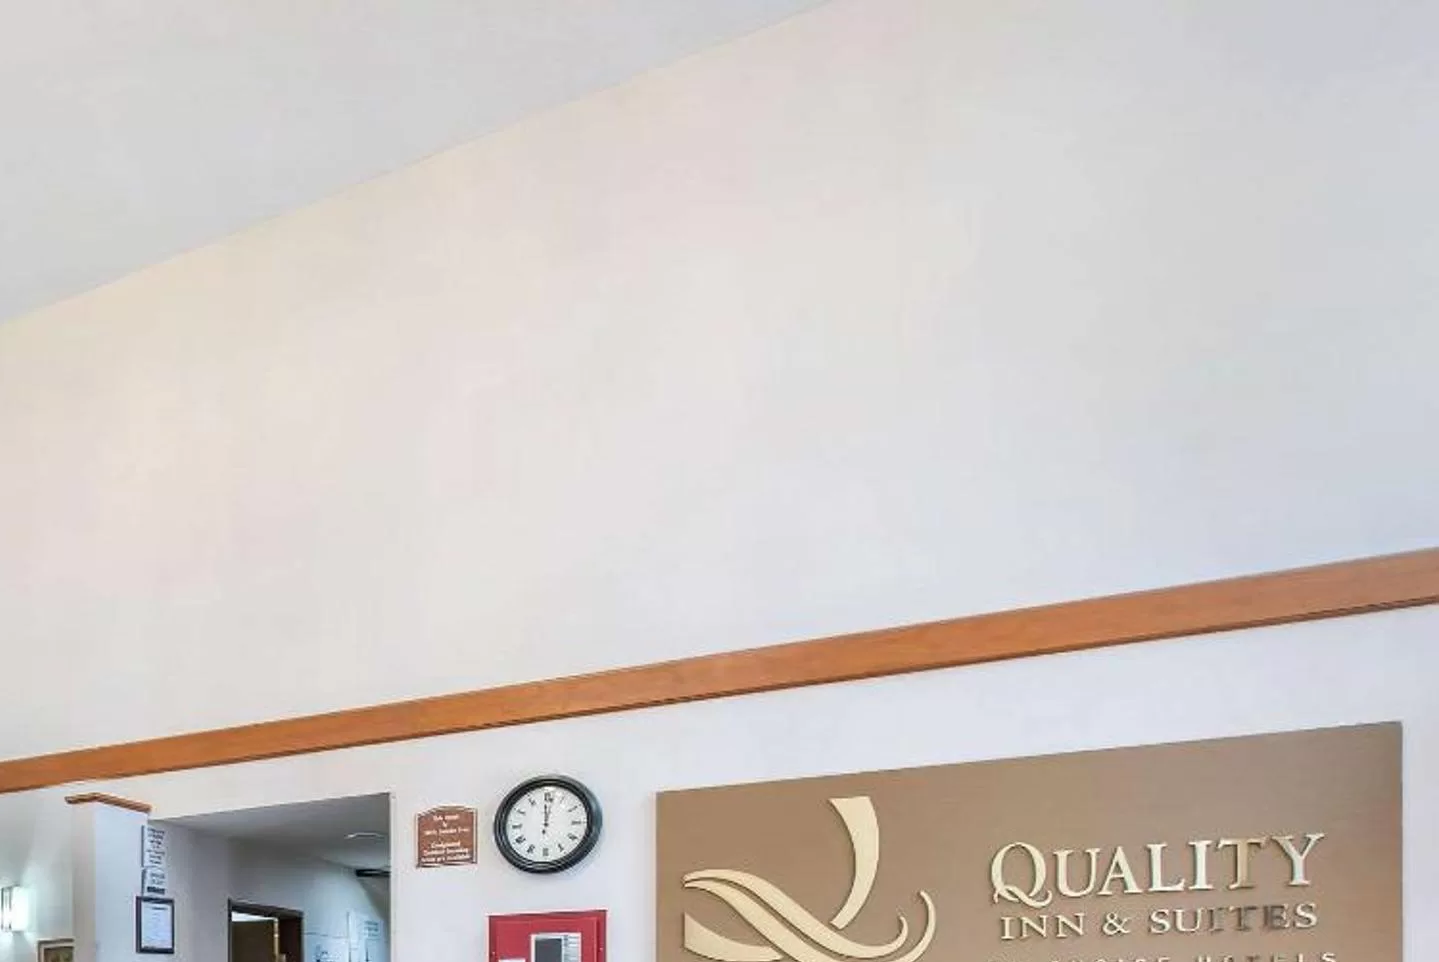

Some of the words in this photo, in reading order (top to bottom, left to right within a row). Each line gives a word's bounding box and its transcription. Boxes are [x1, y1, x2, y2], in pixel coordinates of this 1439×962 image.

[990, 832, 1326, 909] QUALITY
[999, 911, 1087, 942] INN
[1102, 910, 1132, 937] &
[1148, 902, 1320, 935] SUITES
